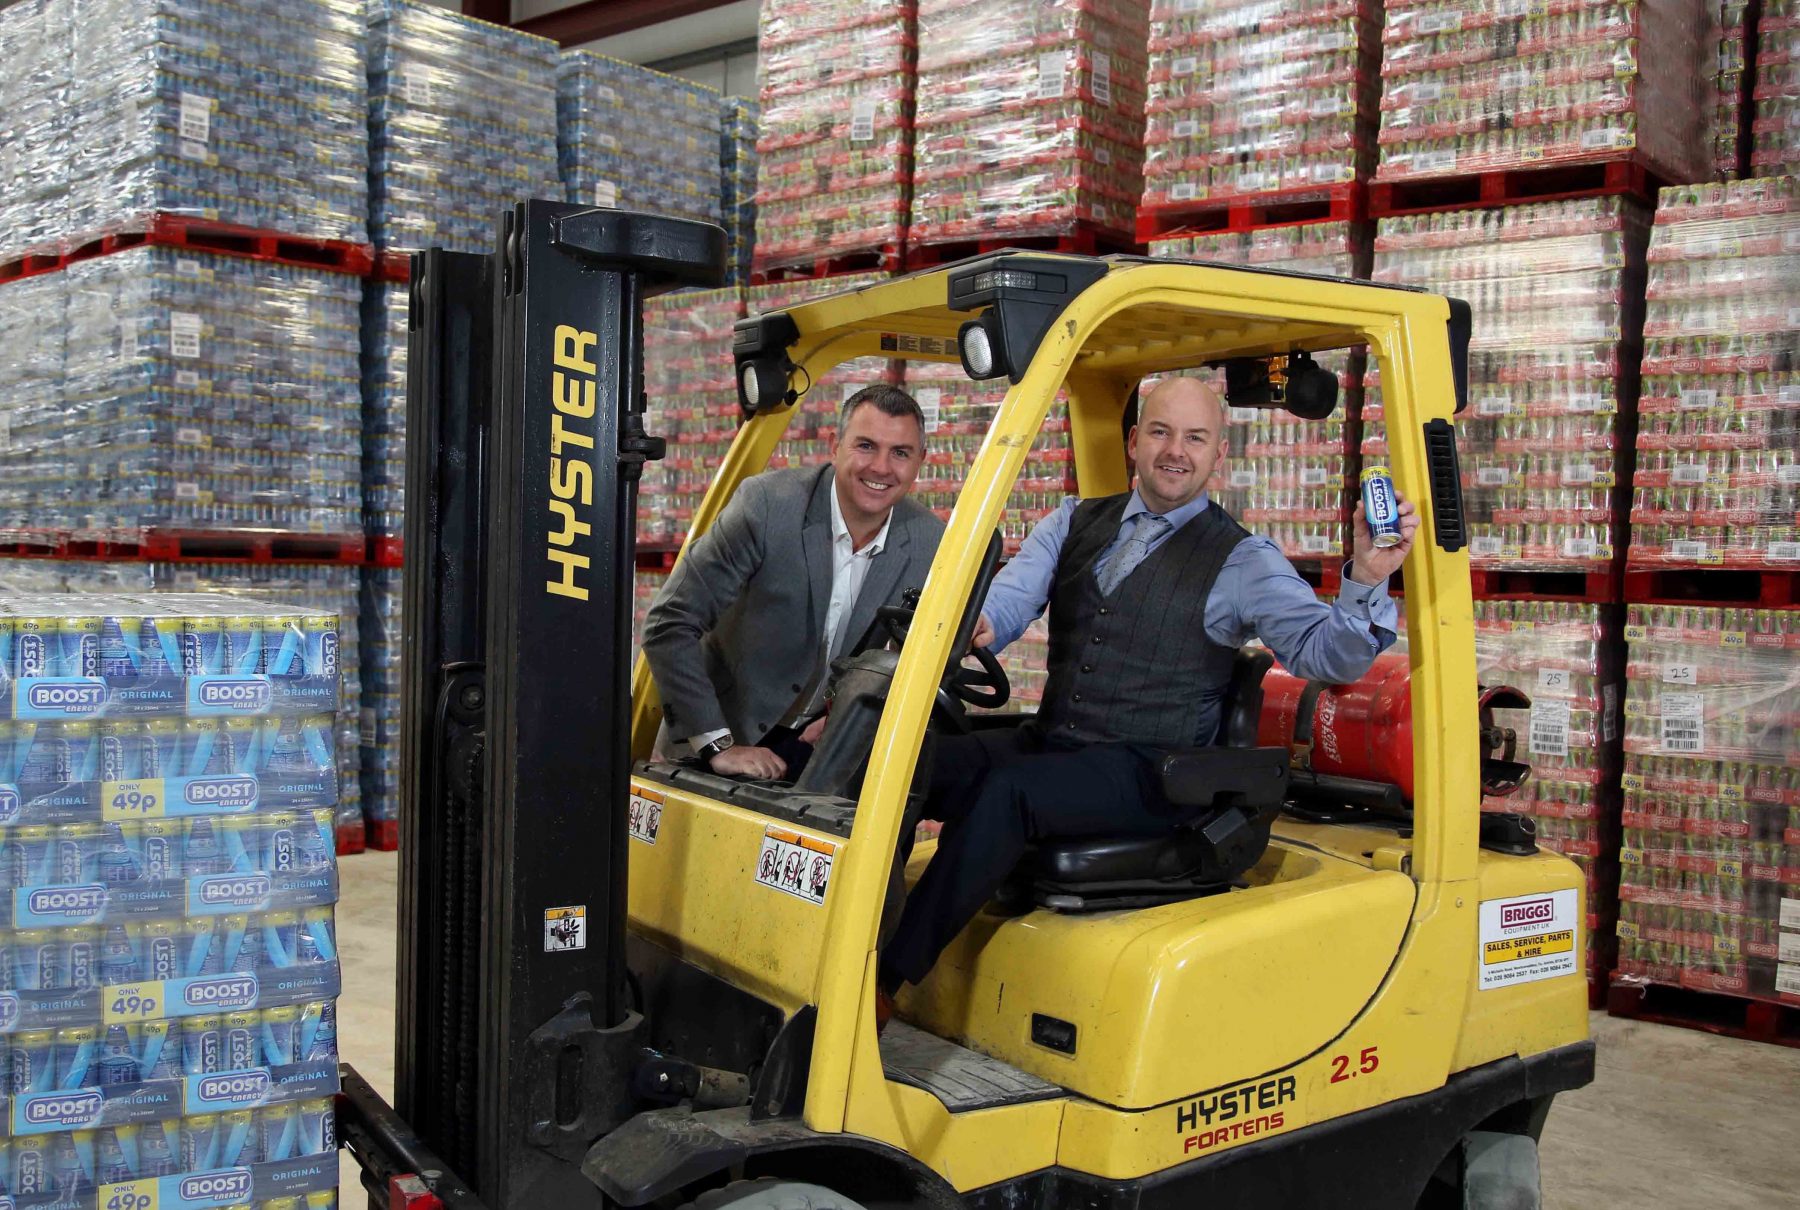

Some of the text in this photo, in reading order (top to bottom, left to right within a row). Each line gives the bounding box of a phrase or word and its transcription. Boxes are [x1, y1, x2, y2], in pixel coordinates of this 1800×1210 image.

[547, 324, 597, 600] HYSTER
[1372, 482, 1387, 517] BOOST
[1547, 673, 1561, 686] 25
[1671, 668, 1689, 679] 25
[37, 689, 100, 703] BOOST
[121, 691, 173, 699] ORIGINAL
[207, 687, 266, 699] BOOST
[193, 783, 252, 799] BOOST
[279, 784, 323, 793] ORIGINAL
[113, 792, 156, 813] 49p
[1721, 865, 1738, 875] 49p
[207, 882, 265, 897] BOOST
[283, 880, 328, 889] ORIGINAL
[37, 891, 100, 909] BOOST
[120, 892, 171, 900] ORIGINAL
[1504, 904, 1550, 922] BRIGGS
[1487, 932, 1570, 952] SALES, SERVICE, PARTS
[1525, 947, 1541, 956] HIRE
[192, 982, 252, 1000] BOOST
[32, 1000, 86, 1010] ORIGINAL
[112, 996, 156, 1016] 49p
[1330, 1046, 1379, 1083] 2.5
[281, 1072, 328, 1085] ORIGINAL
[206, 1077, 264, 1096] BOOST
[34, 1097, 98, 1118] BOOST
[1177, 1075, 1296, 1134] HYSTER
[1184, 1112, 1284, 1154] FORTENS
[273, 1167, 321, 1181] ORIGINAL
[114, 1185, 135, 1193] ONLY
[188, 1176, 247, 1195] BOOST
[107, 1193, 152, 1210] 49p
[214, 1191, 244, 1200] ENERGY
